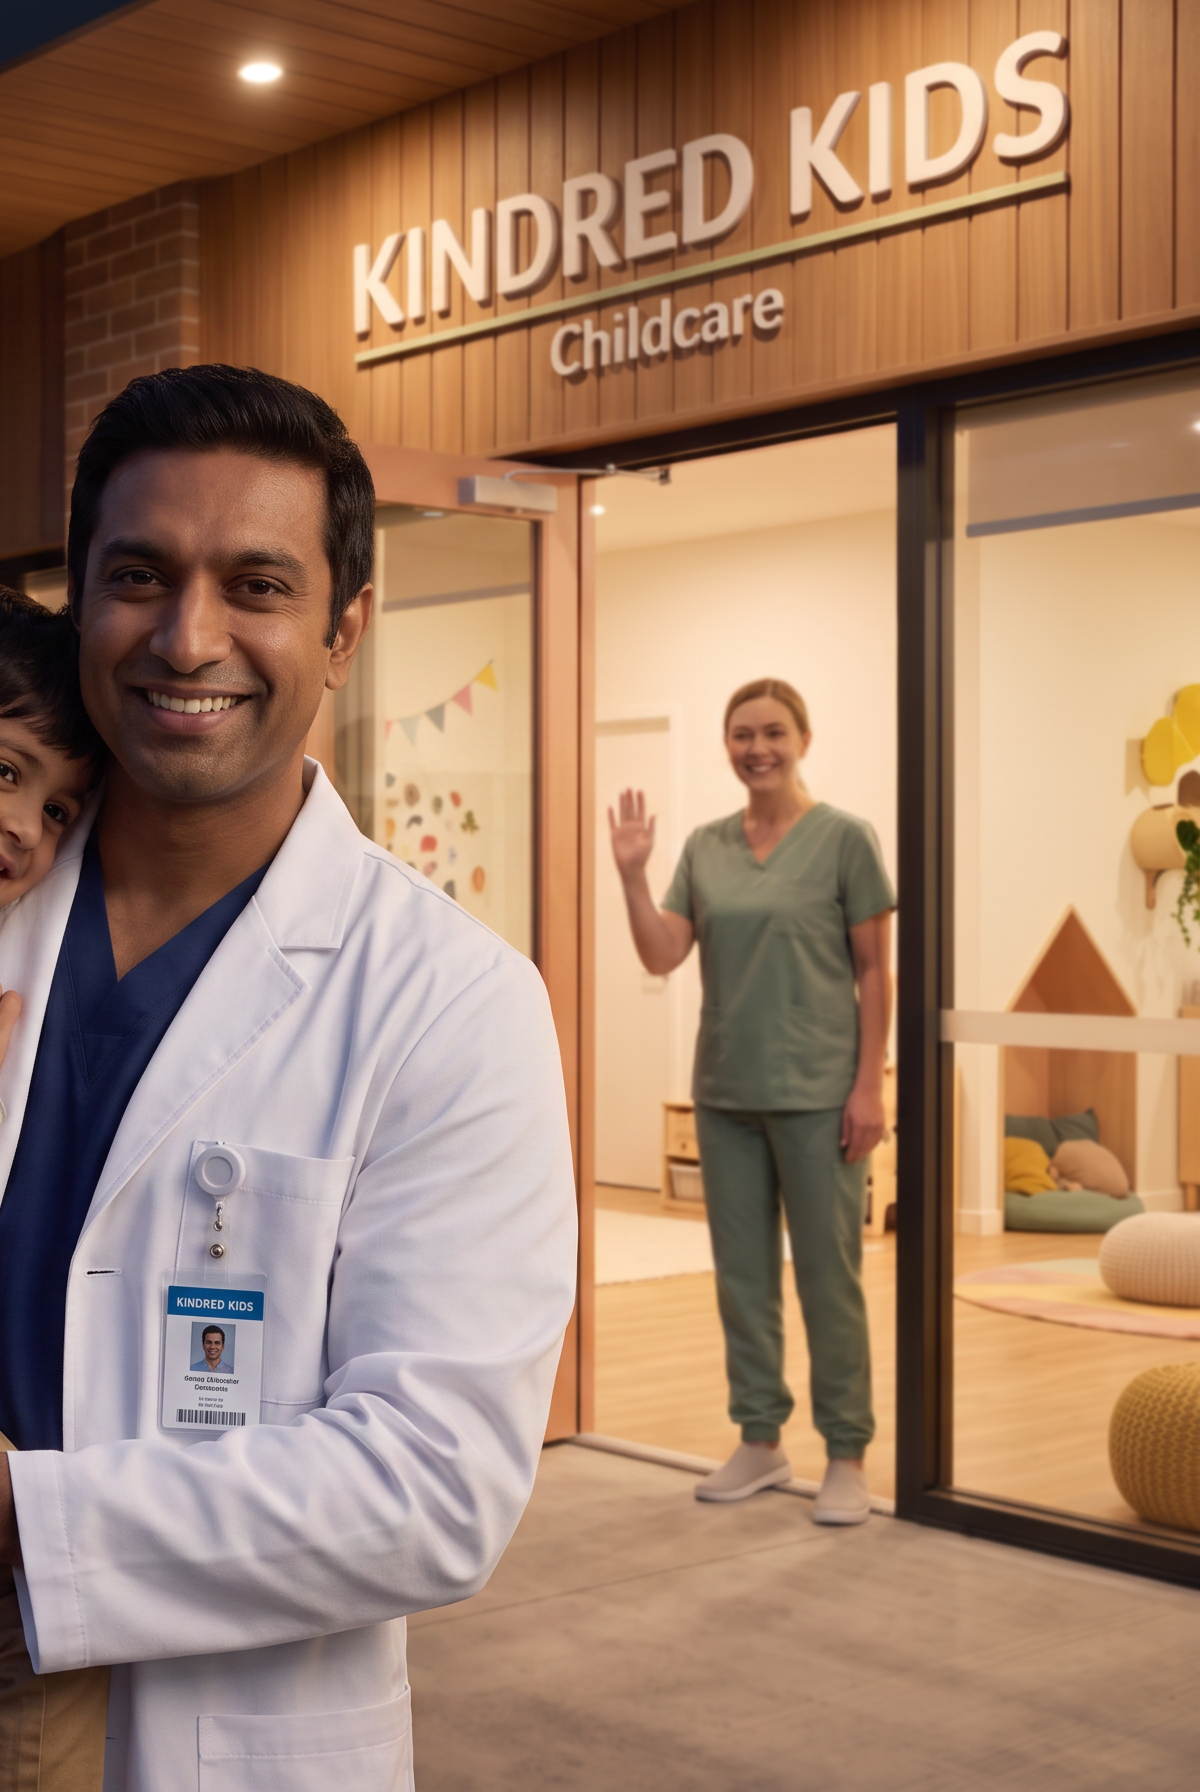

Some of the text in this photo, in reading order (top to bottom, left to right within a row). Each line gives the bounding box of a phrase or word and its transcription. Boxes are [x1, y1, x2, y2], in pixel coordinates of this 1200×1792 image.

[353, 30, 1069, 335] KINDRED KIDS
[550, 288, 785, 377] Childcare
[176, 1297, 254, 1312] KINDRED KIDS
